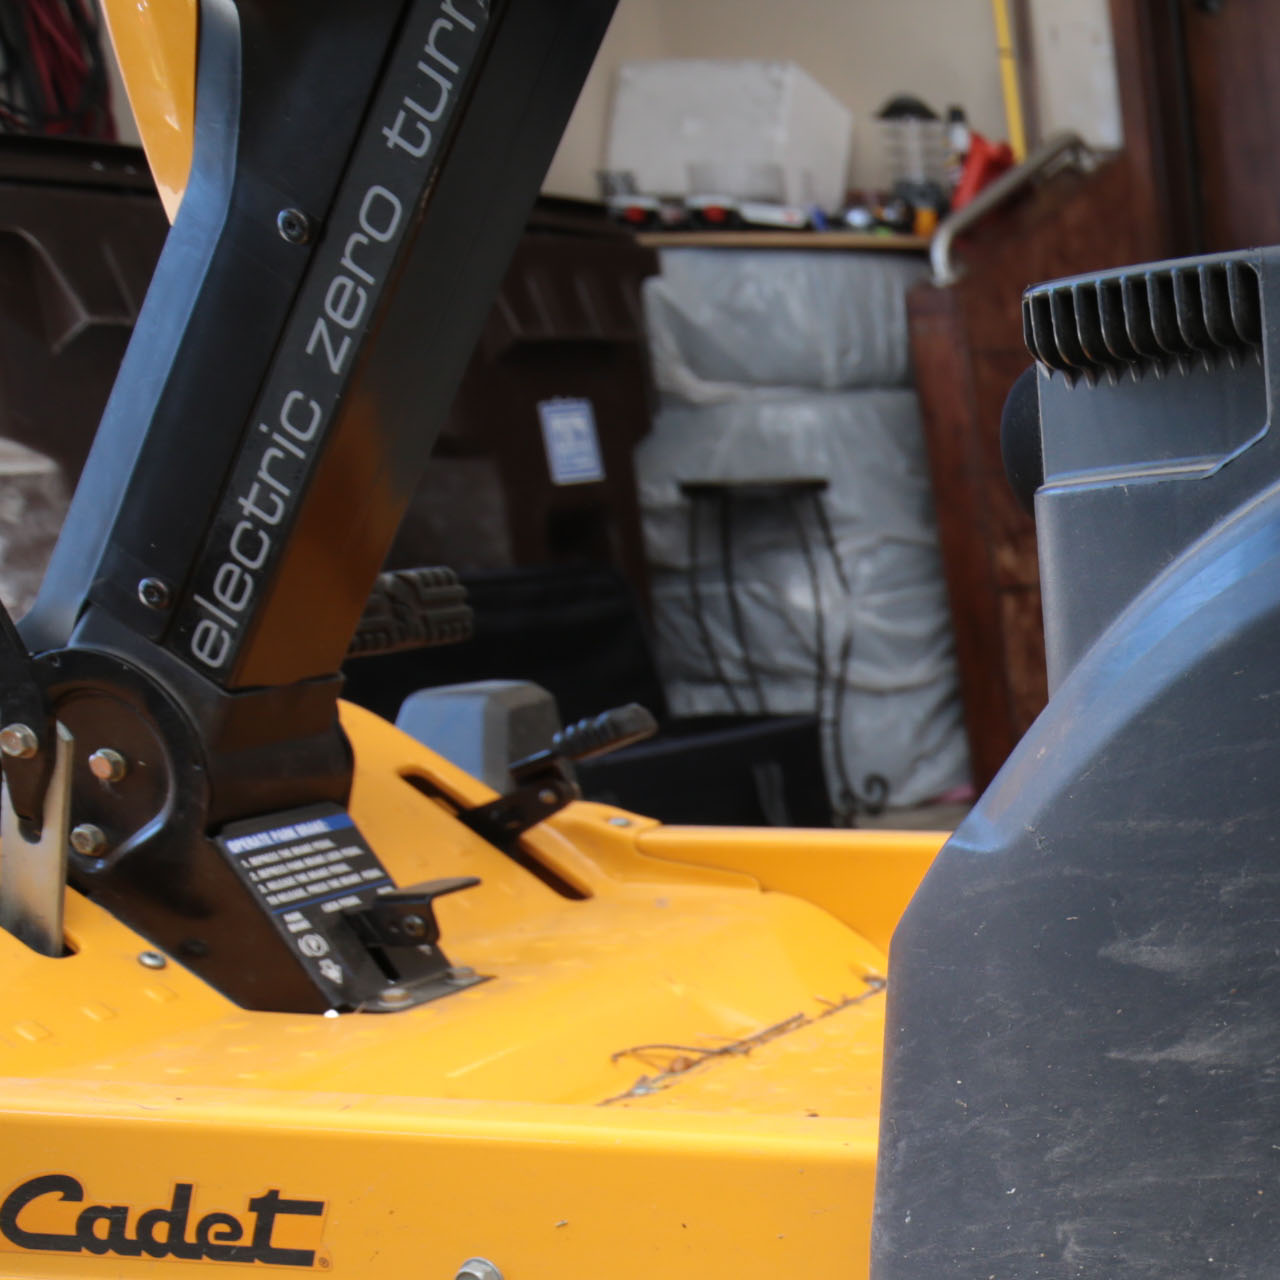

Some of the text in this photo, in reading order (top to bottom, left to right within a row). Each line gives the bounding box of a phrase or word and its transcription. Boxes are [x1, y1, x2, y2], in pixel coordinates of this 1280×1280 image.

[190, 390, 323, 669] electric
[305, 184, 403, 375] zero
[0, 1174, 324, 1267] Cadet
